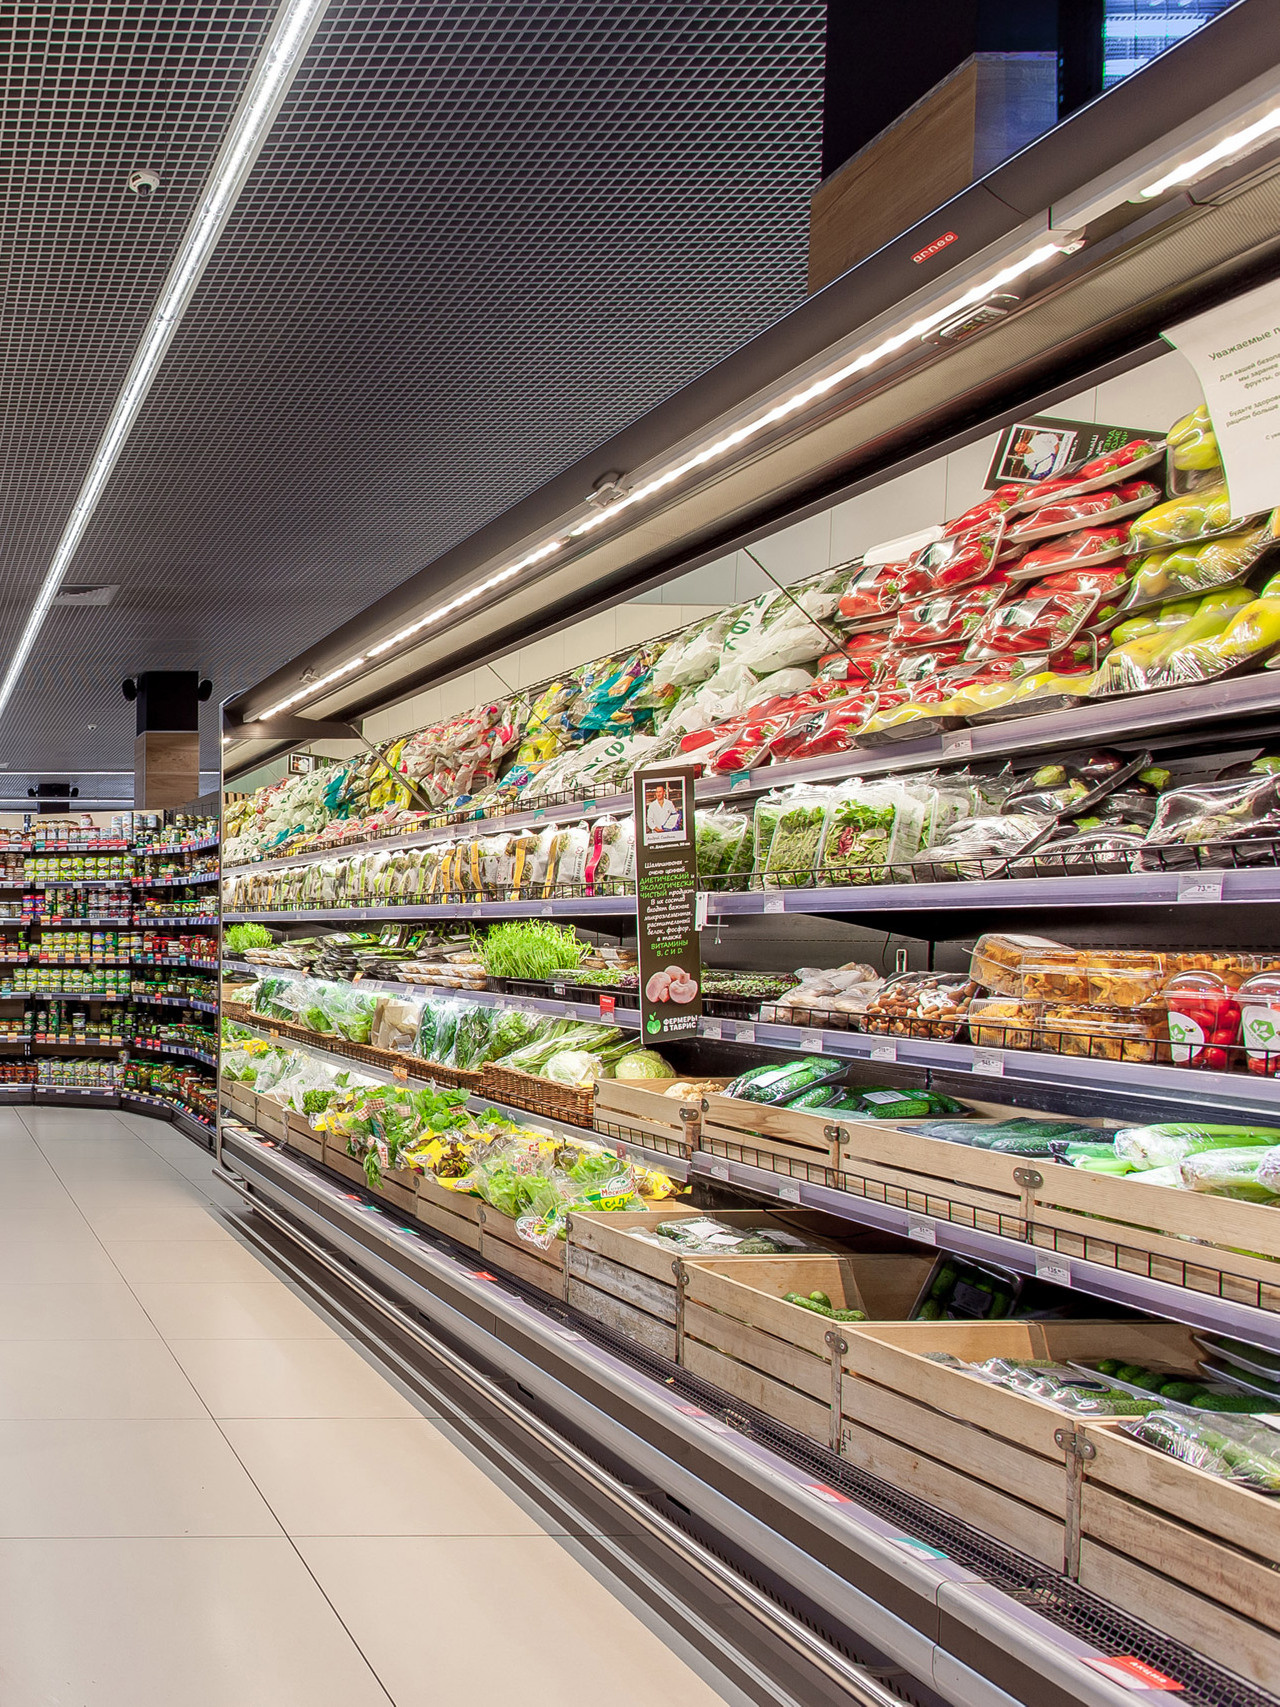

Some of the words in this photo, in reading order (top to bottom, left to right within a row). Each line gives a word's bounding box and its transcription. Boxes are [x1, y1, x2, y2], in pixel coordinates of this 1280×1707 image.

[1208, 331, 1271, 360] Уважаемые
[639, 872, 690, 885] ДИЕТИЧЕСКИЙ
[640, 880, 694, 892] ЭКОЛОГИЧЕСКИ
[640, 890, 667, 898] ЧИСТЫЙ
[650, 940, 688, 950] ВИТАМИНЫ
[663, 1014, 698, 1026] ФЕРМЕРЫ
[670, 1022, 696, 1031] ТАБРИС
